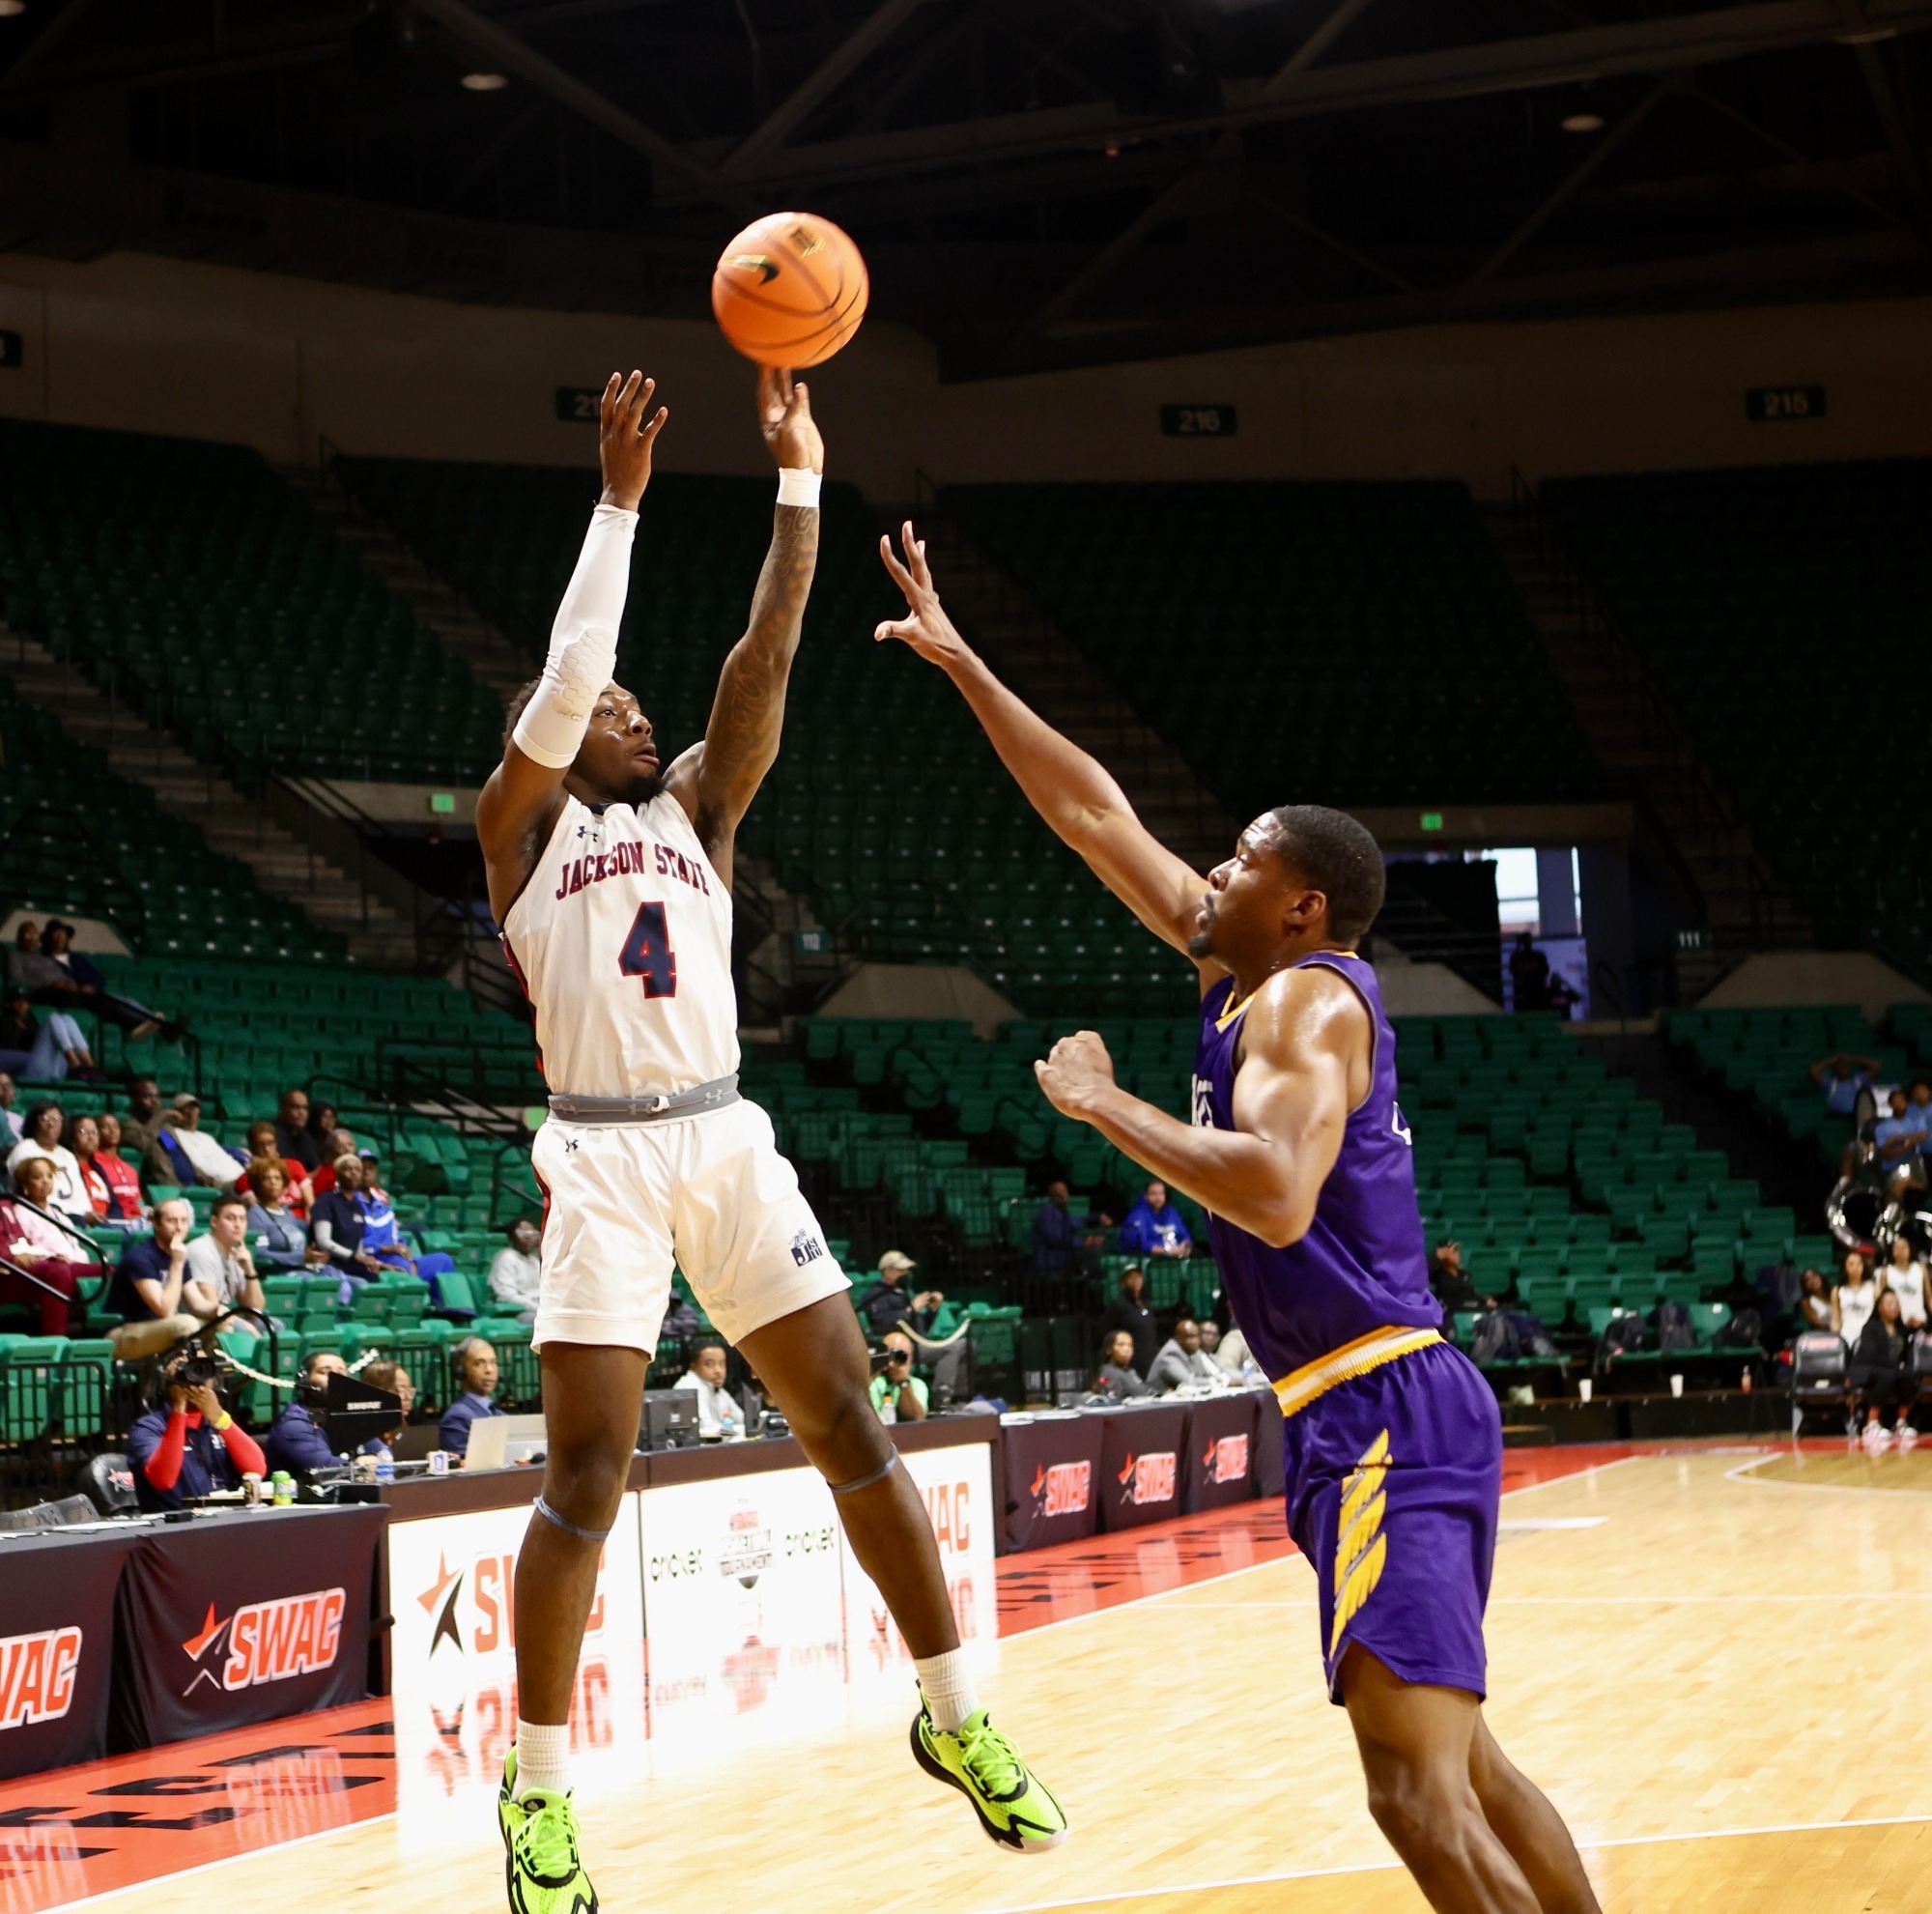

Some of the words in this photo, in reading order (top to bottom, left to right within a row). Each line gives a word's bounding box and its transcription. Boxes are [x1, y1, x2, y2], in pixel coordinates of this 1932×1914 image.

[555, 842, 644, 900] JACKSON
[618, 901, 677, 999] 4
[223, 1587, 346, 1691] SWAC
